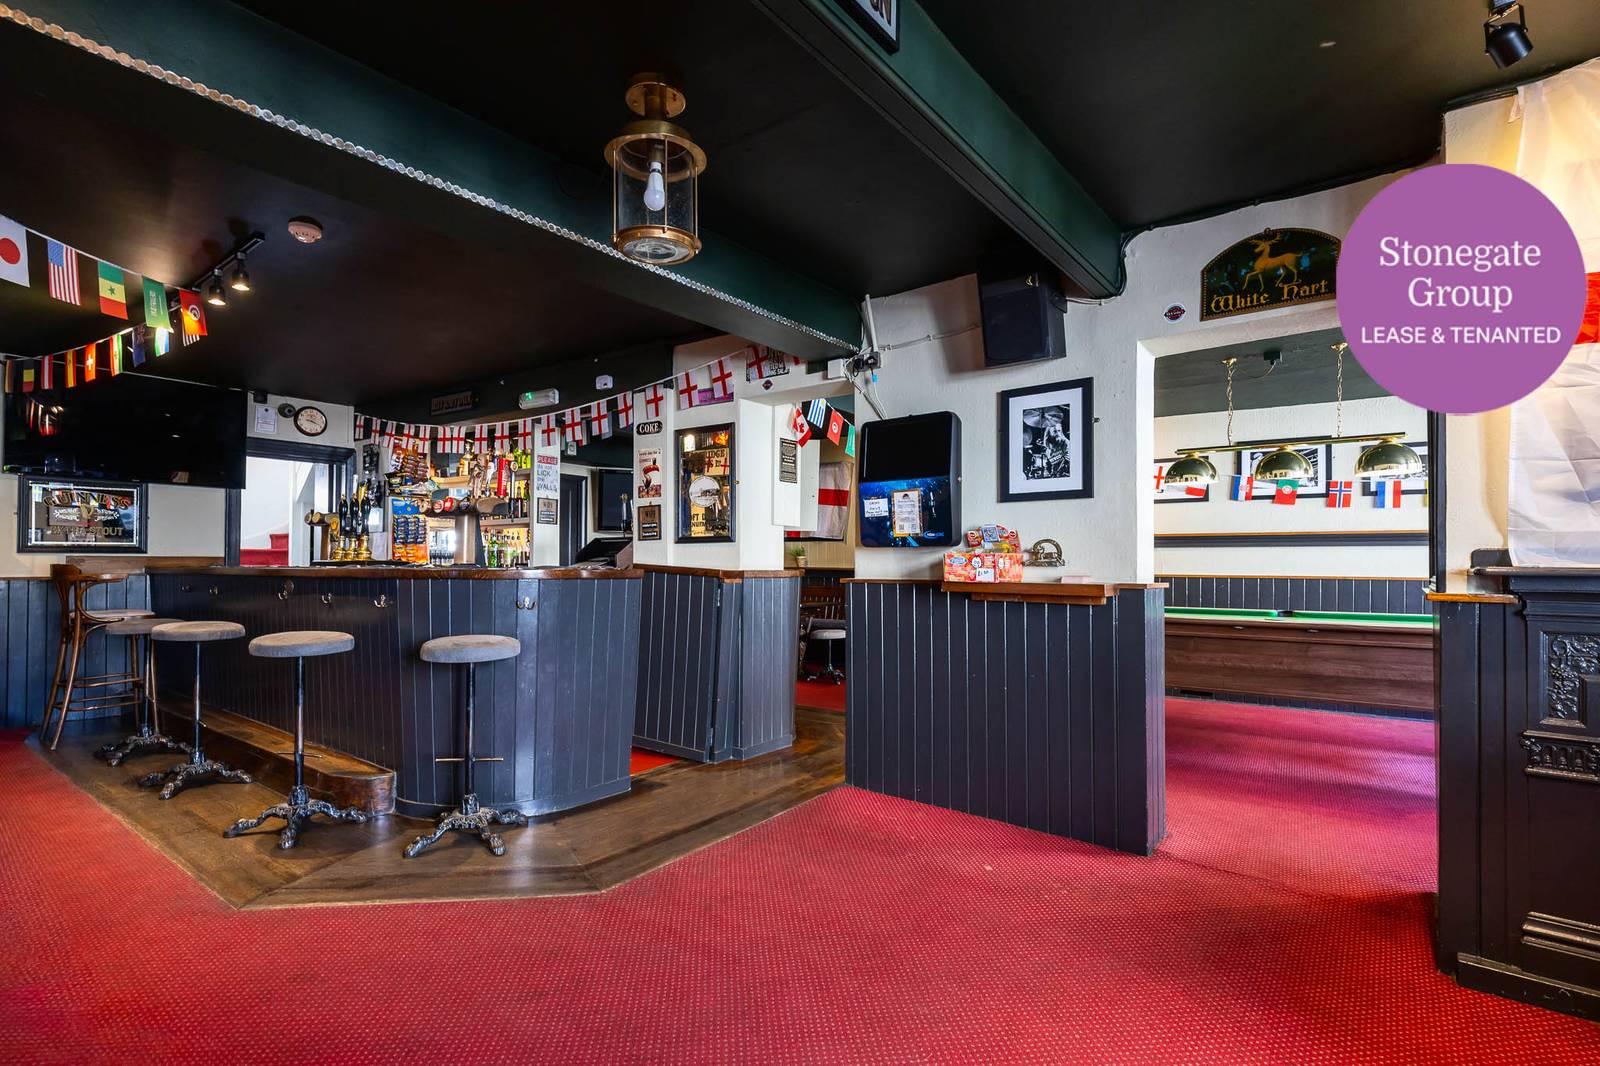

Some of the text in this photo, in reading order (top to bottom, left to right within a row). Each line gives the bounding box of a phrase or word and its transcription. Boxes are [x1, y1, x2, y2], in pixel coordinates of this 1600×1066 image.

[1211, 280, 1328, 313] White Hart
[639, 423, 659, 433] COKE
[537, 455, 558, 465] PLEASE
[537, 470, 551, 478] LICK
[43, 492, 130, 510] GUINNESS
[90, 526, 123, 536] STOUT
